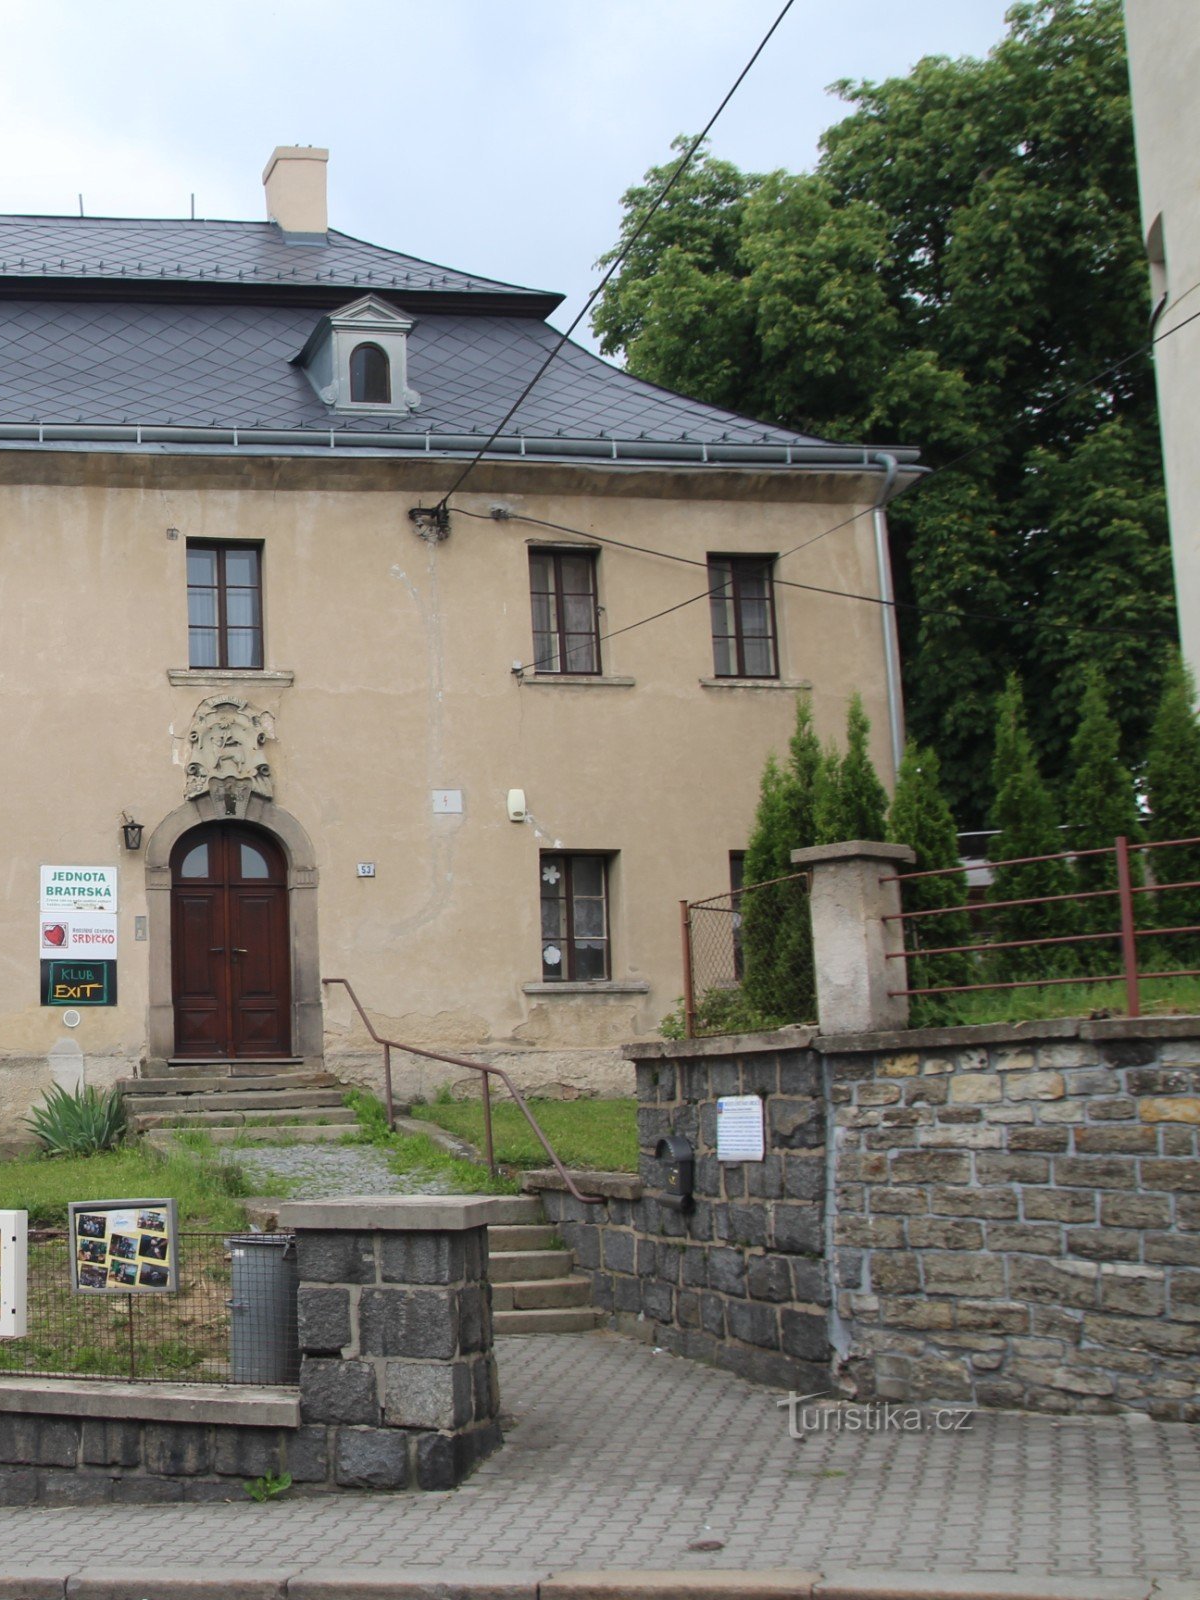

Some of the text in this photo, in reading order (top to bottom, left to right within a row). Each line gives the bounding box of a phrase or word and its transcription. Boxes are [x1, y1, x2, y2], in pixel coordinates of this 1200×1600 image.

[361, 865, 372, 874] 53
[52, 871, 106, 883] JEDNOTA
[46, 885, 112, 897] BRATRSKÁ
[61, 968, 95, 981] KLUB
[53, 983, 104, 998] EXIT
